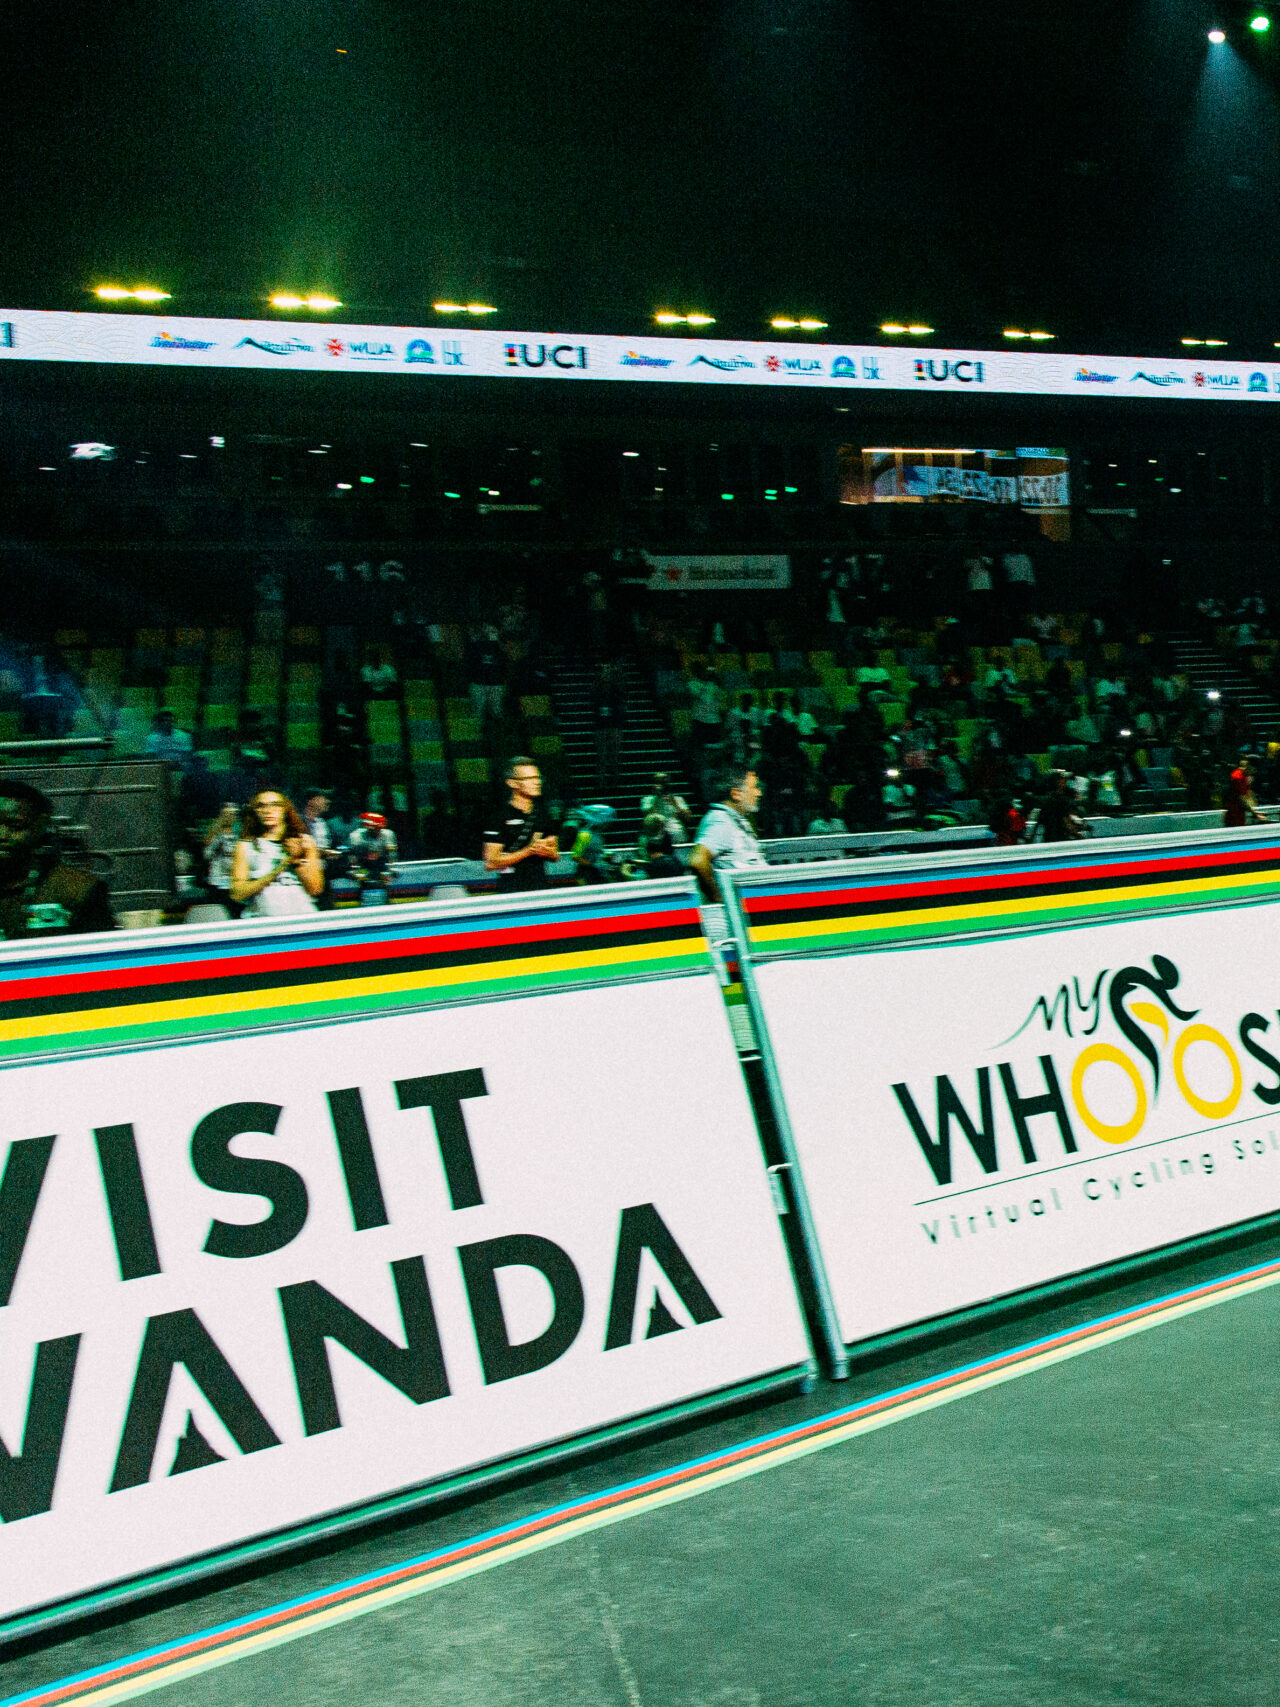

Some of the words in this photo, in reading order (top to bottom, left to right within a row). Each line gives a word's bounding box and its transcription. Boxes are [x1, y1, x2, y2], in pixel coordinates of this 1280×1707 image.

[520, 343, 588, 370] UCI
[928, 358, 984, 383] UCI
[921, 1187, 1063, 1245] Virtual
[1082, 1152, 1216, 1201] Cycling
